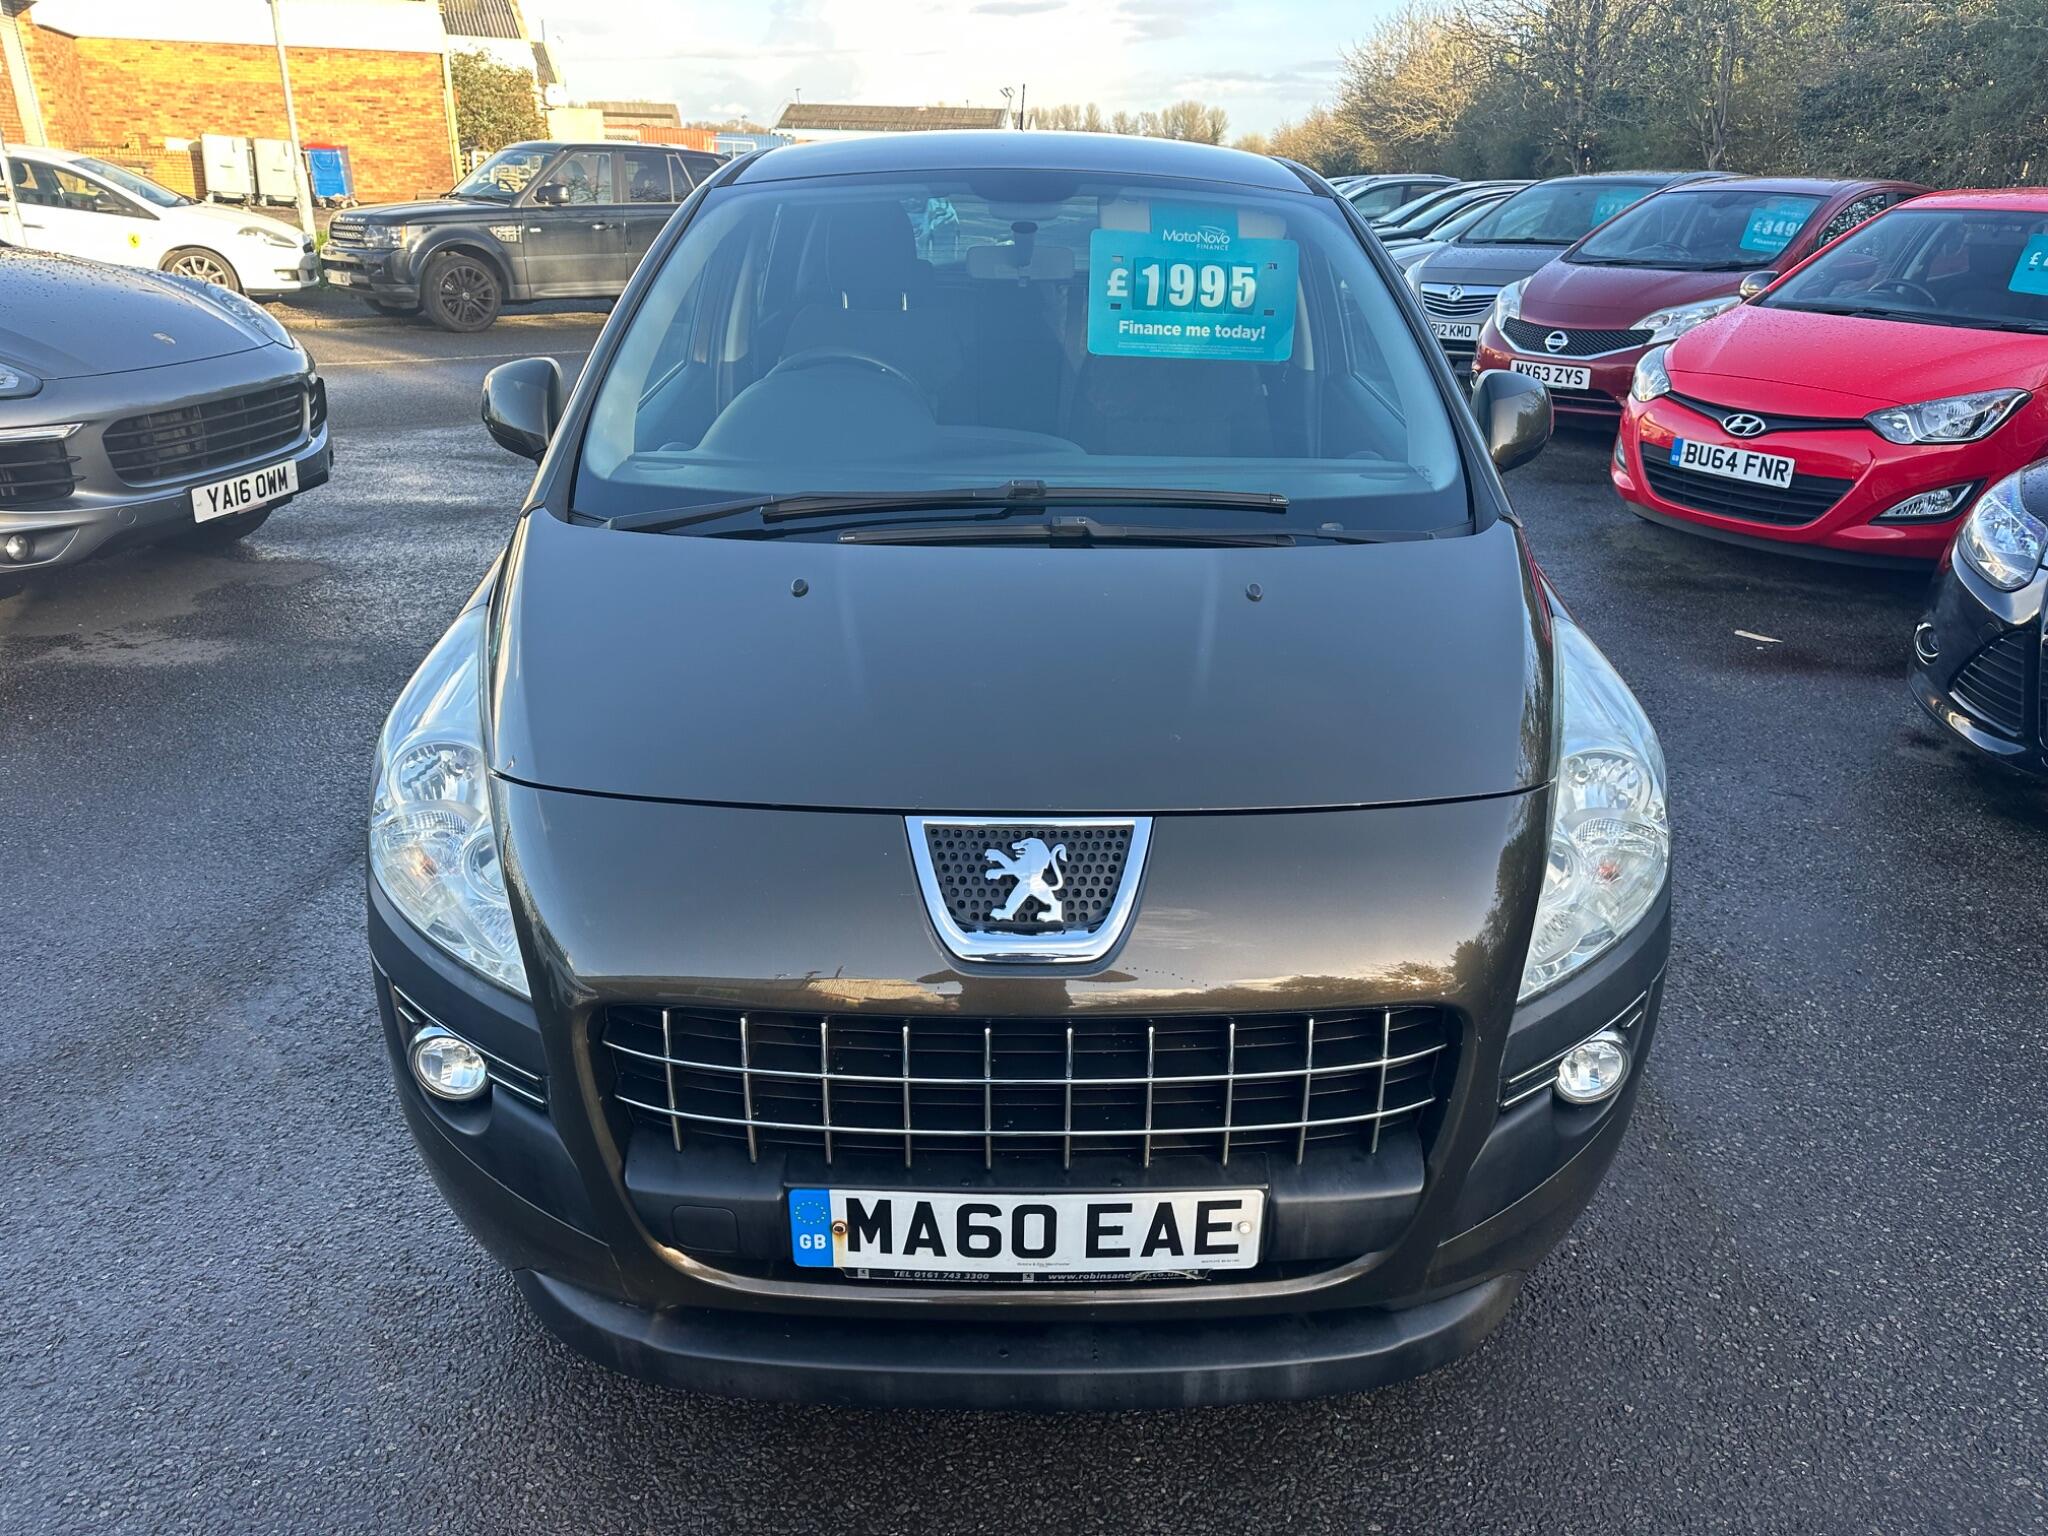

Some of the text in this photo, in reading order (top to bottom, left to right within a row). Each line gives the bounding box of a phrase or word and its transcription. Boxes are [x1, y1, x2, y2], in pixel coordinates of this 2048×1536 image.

[1162, 228, 1231, 245] MotoNovo
[1196, 243, 1229, 251] FINANCE
[1119, 319, 1267, 341] Finance me today!
[1449, 324, 1472, 338] KMO
[1553, 367, 1585, 385] ZYS
[1684, 442, 1790, 482] BU64 FNR
[206, 465, 289, 513] YA16 OWM
[846, 1197, 1243, 1259] MA60 EAE
[799, 1233, 827, 1250] GB
[893, 1270, 911, 1278] TEL
[914, 1271, 938, 1279] 0161
[942, 1272, 961, 1280] 743
